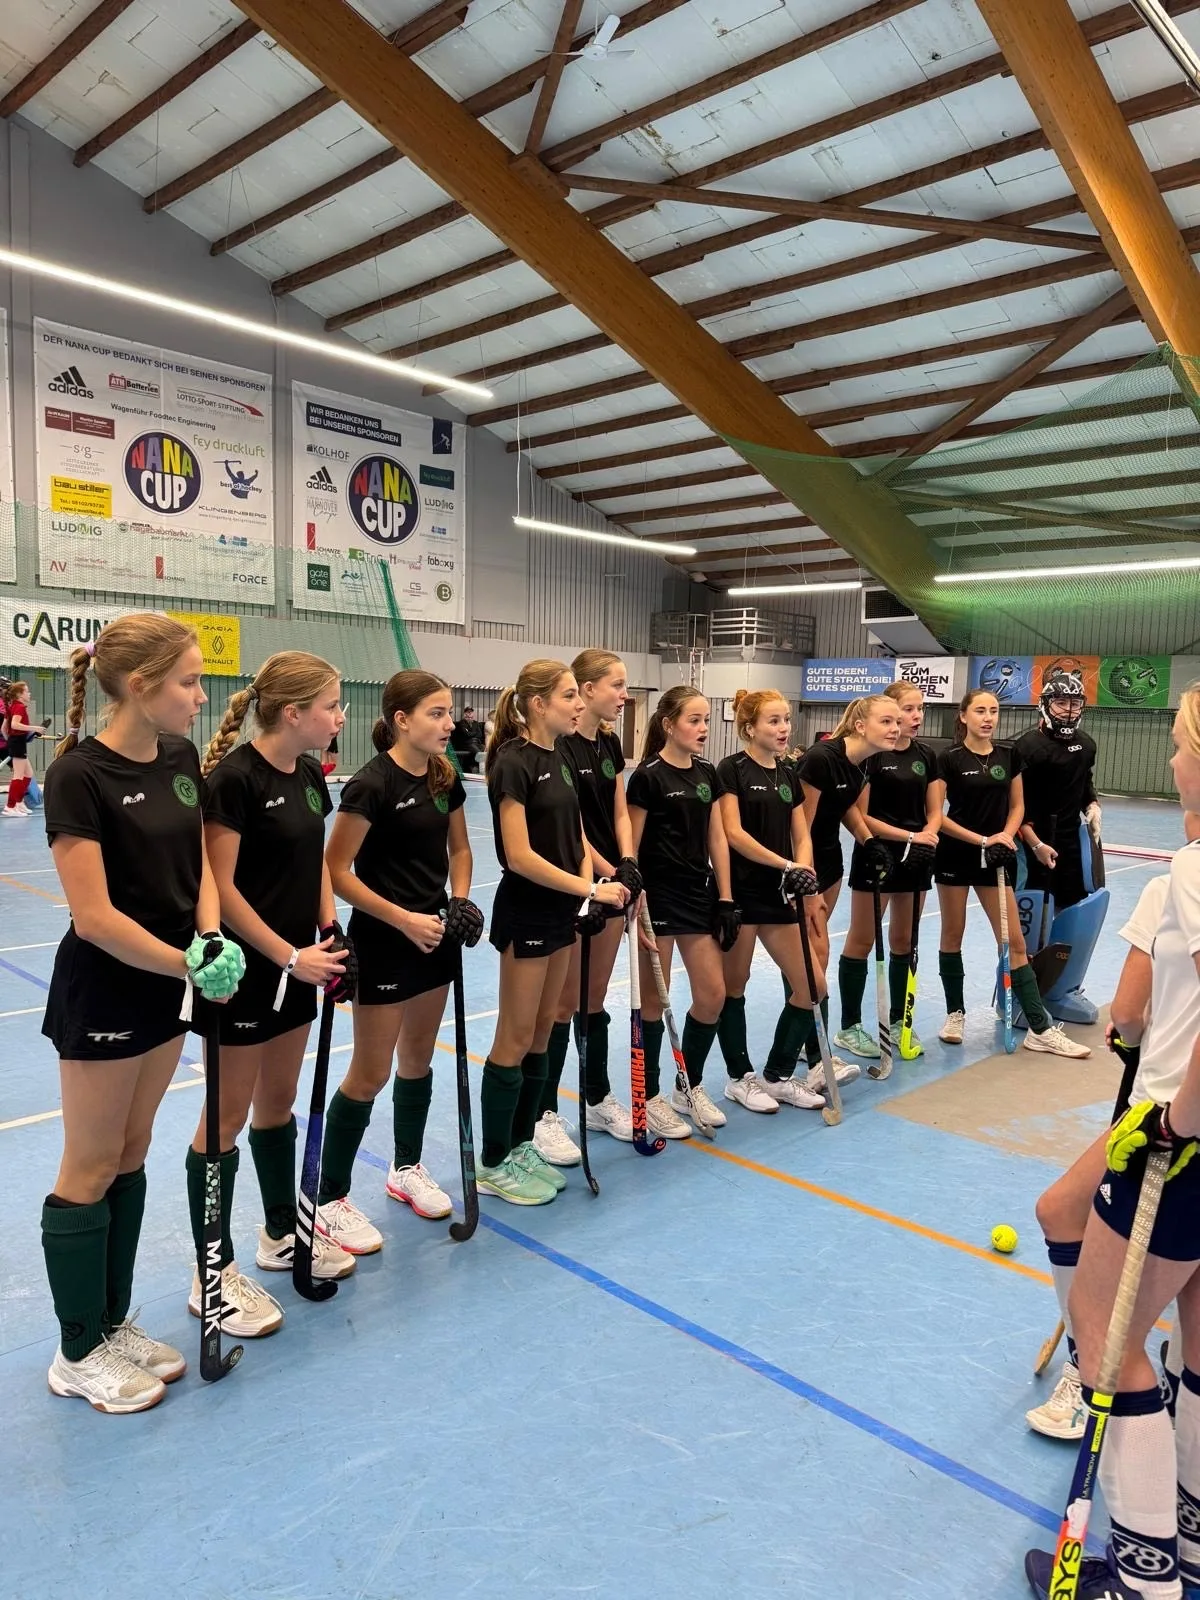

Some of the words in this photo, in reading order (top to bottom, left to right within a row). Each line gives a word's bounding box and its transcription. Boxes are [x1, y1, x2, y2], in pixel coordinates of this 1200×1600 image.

[43, 334, 63, 344] DER
[65, 339, 90, 352] NANA
[92, 346, 111, 356] CUP
[113, 350, 153, 366] BEDANKT
[154, 360, 173, 371] SICH
[175, 365, 189, 374] BEI
[190, 368, 219, 382] SEINEN
[219, 376, 266, 392] SPONSOREN
[48, 381, 95, 399] adidas
[111, 402, 149, 416] Wagenführ
[149, 410, 177, 422] Foodtec
[177, 416, 216, 430] Engineering
[310, 406, 324, 415] WIR
[325, 409, 363, 424] BEDANKEN
[364, 420, 379, 429] UNS
[309, 416, 322, 425] BEI
[323, 419, 356, 433] UNSEREN
[357, 427, 399, 442] SPONSOREN
[131, 436, 194, 478] NANA
[213, 438, 265, 458] druckluft
[140, 470, 187, 509] CUP
[220, 481, 232, 489] best
[306, 481, 338, 493] adidas
[354, 461, 412, 504] NANA
[361, 497, 406, 538] CUP
[233, 573, 268, 585] FORCE
[806, 676, 832, 684] GUTE
[833, 676, 891, 684] STRATEGIE!
[834, 667, 868, 675] IDEEN!
[901, 667, 930, 676] ZUM
[901, 675, 949, 684] HOHEN
[806, 684, 838, 692] GUTES
[840, 684, 871, 692] SPIEL!
[87, 1031, 134, 1042] TK
[631, 1048, 648, 1131] PRINCESS
[204, 1237, 222, 1338] MALIK
